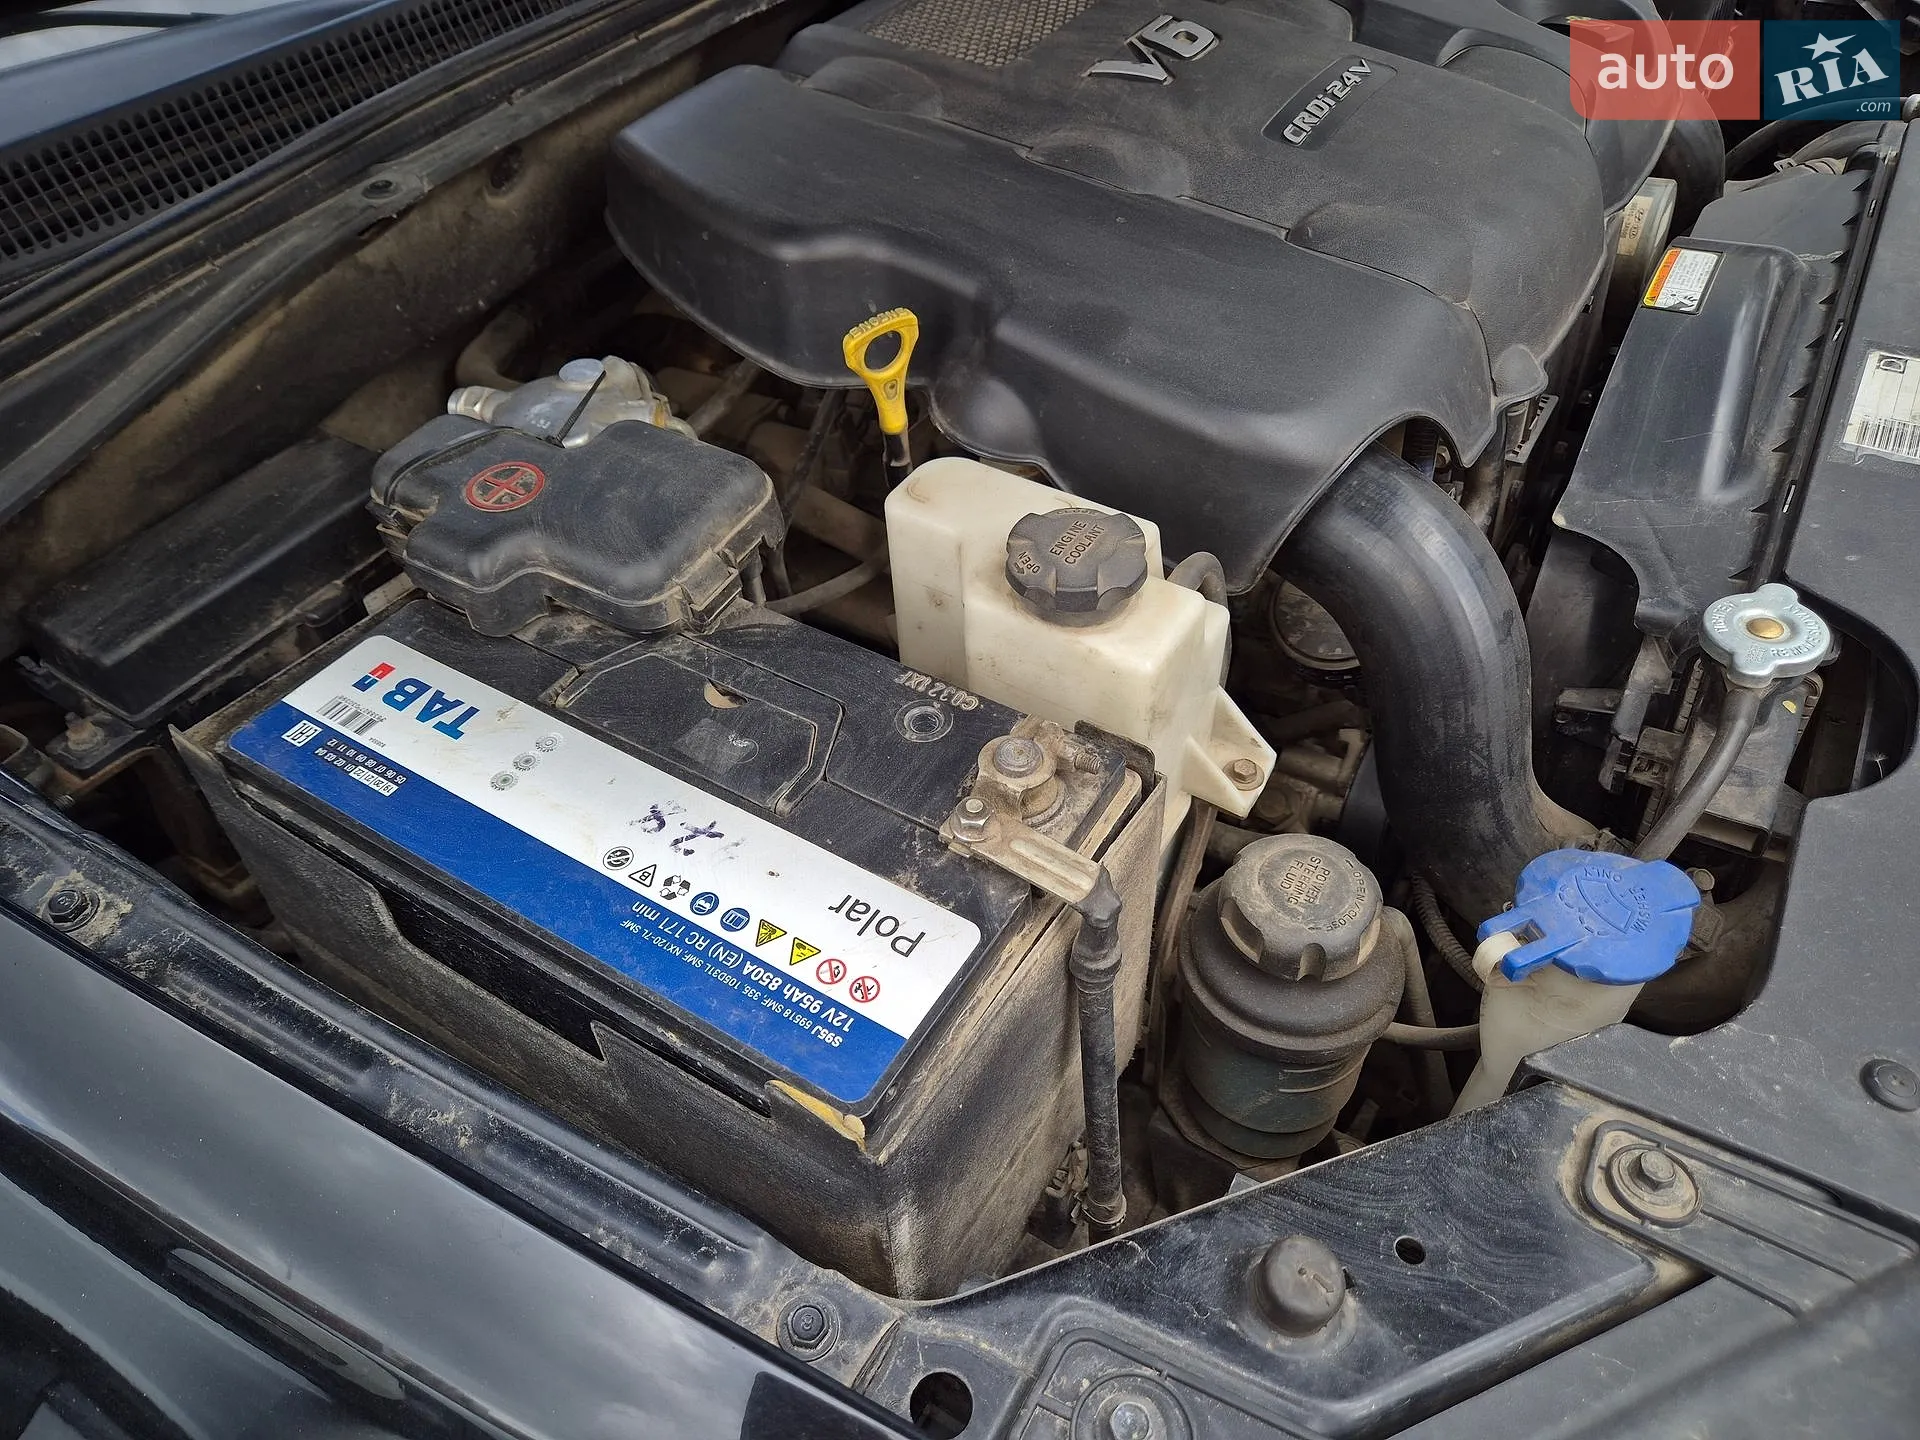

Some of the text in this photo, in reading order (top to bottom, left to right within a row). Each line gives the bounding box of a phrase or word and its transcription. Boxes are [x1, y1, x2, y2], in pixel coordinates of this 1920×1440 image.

[1082, 14, 1218, 84] V6
[1282, 58, 1372, 146] CRDi 24V
[1050, 520, 1087, 556] ENGINE
[1064, 524, 1105, 565] COOLANT
[1018, 551, 1041, 574] OPEN
[381, 677, 481, 741] TAB
[1280, 860, 1304, 890] FLUID
[1287, 856, 1322, 905] STEERING
[1304, 867, 1331, 904] POWER
[619, 919, 642, 934] SMF
[641, 928, 684, 957] NX120-7L
[828, 894, 926, 958] Polar
[631, 900, 855, 1033] 12V 95Ah 850A (EN) RC 171 min
[703, 963, 741, 990] 105D31L
[783, 1009, 813, 1030] 59518
[810, 1025, 844, 1048] S95J
